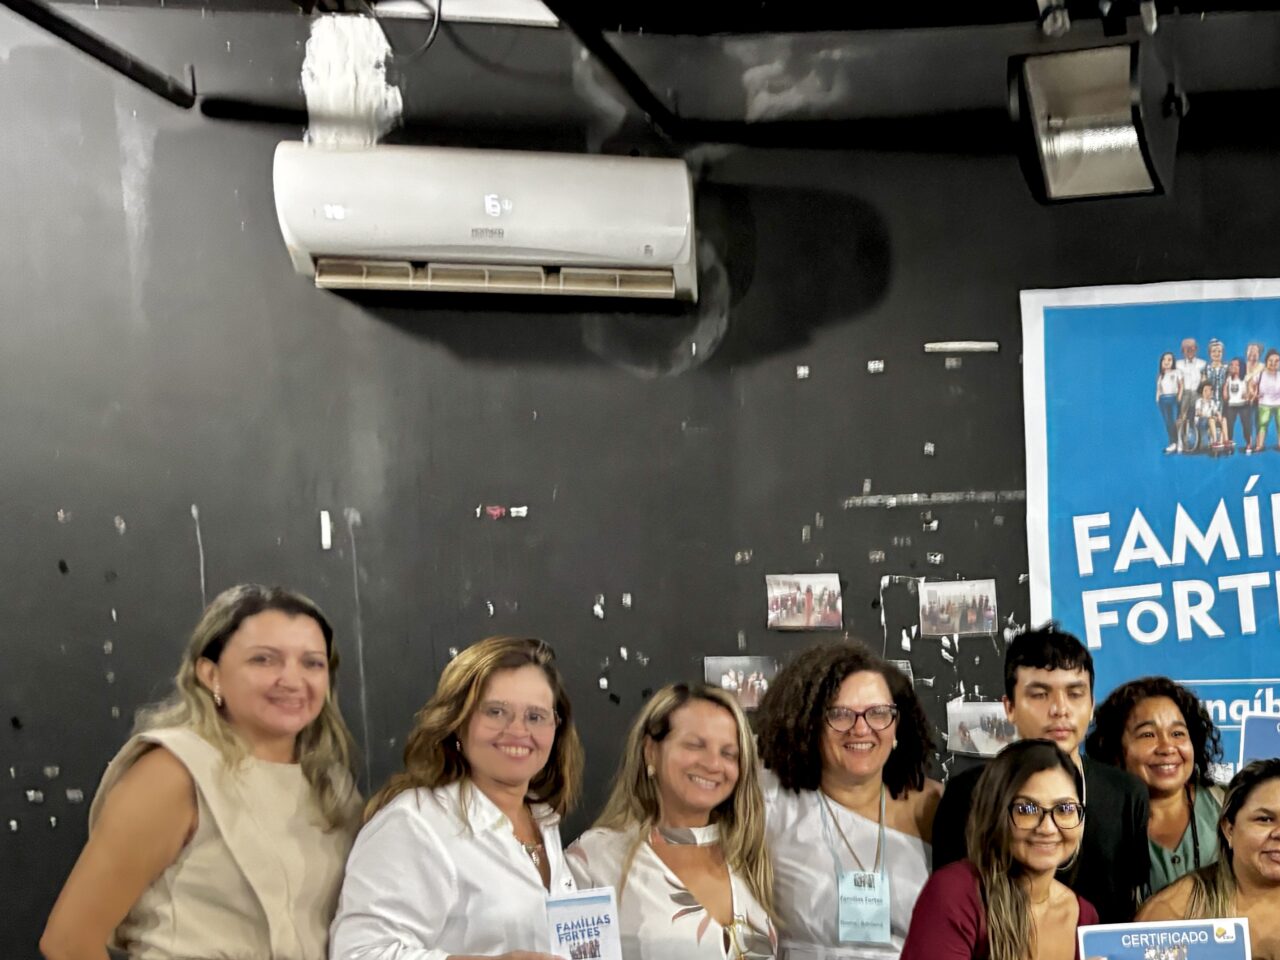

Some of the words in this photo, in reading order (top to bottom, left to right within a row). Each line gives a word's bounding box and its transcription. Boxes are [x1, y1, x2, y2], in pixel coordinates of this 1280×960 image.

[556, 914, 611, 933] FAMÍLIAS
[559, 927, 600, 944] FORTES
[1121, 931, 1209, 946] CERTIFICADO
